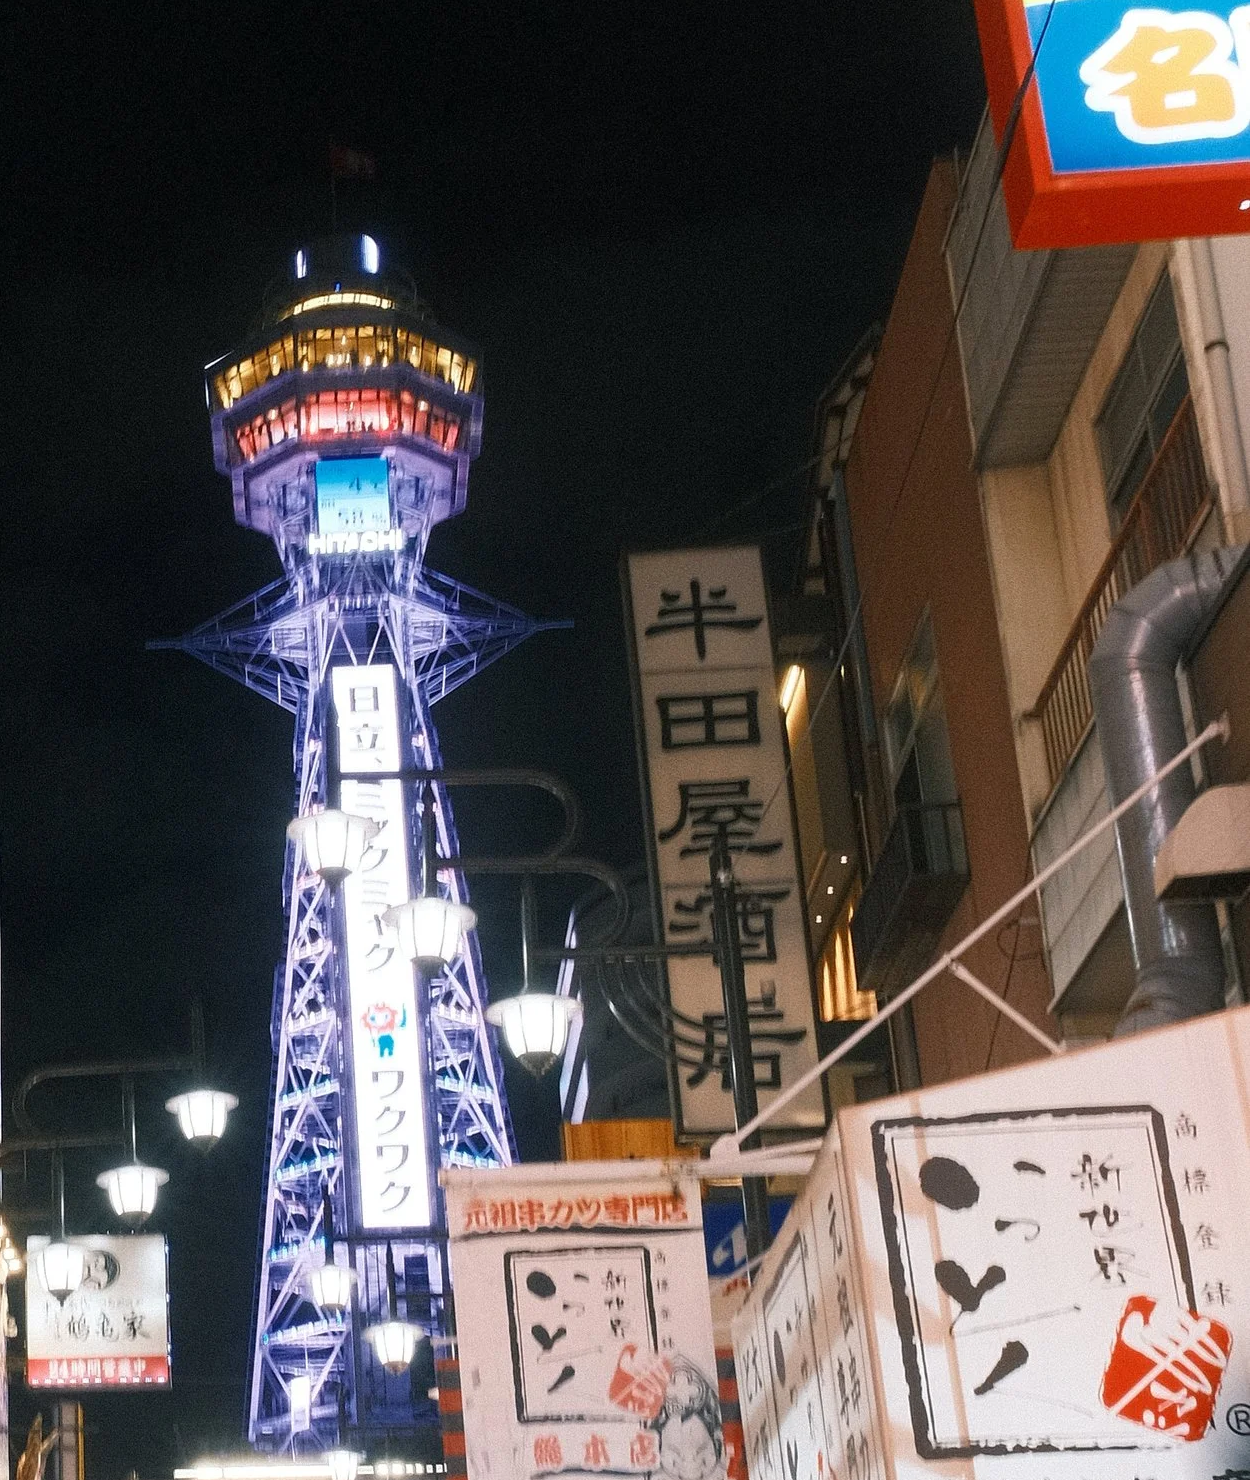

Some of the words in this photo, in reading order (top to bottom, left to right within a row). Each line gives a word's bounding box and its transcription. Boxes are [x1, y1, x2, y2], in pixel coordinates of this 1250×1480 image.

[308, 528, 404, 555] HITACHI
[371, 1069, 413, 1212] ワクワク
[464, 1191, 689, 1233] 元祖串カツ専門店
[1071, 1151, 1143, 1285] 新世界
